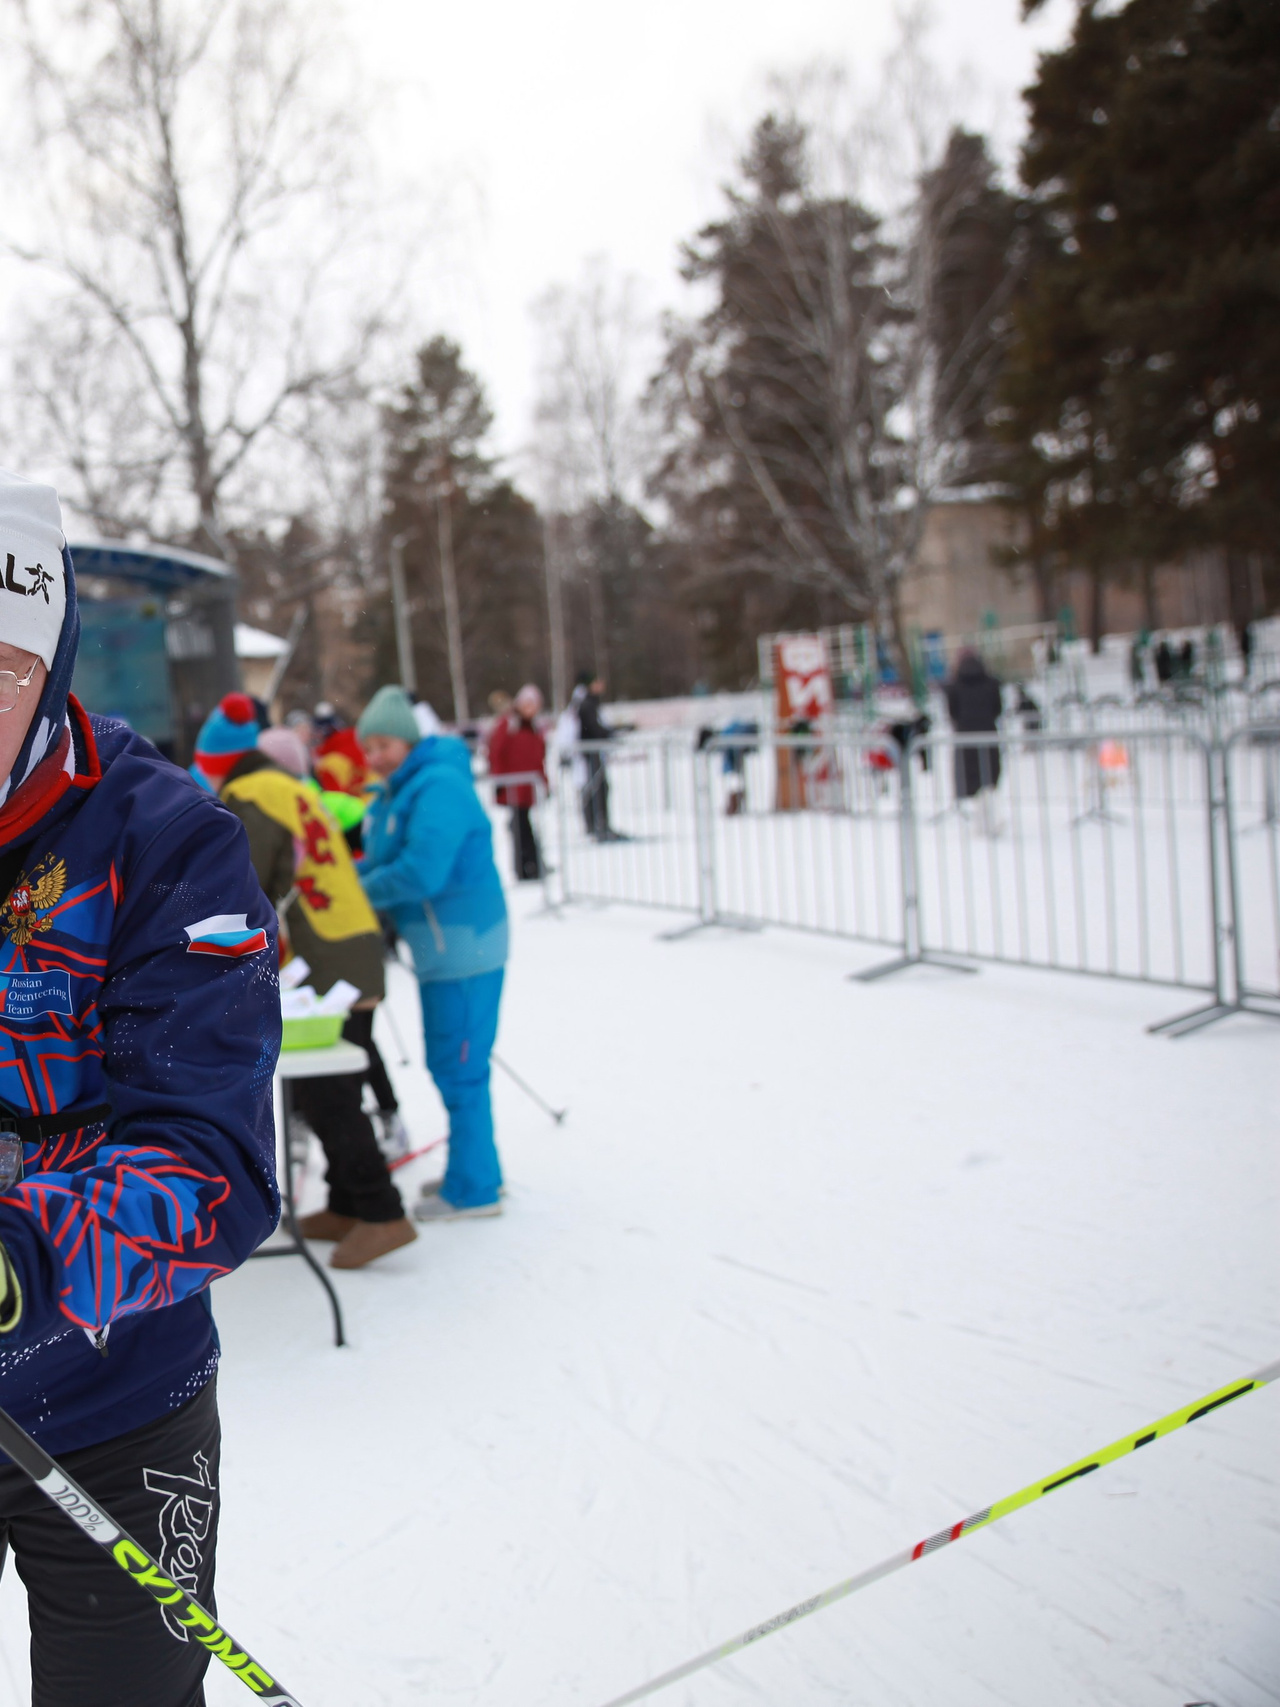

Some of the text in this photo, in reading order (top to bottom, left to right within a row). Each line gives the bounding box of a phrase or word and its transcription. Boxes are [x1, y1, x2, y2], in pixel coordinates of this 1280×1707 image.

[11, 978, 43, 988] Russian
[8, 986, 67, 1001] Orienteering
[6, 1003, 33, 1015] Team
[49, 1484, 106, 1532] 100%
[179, 1601, 274, 1693] TIME
